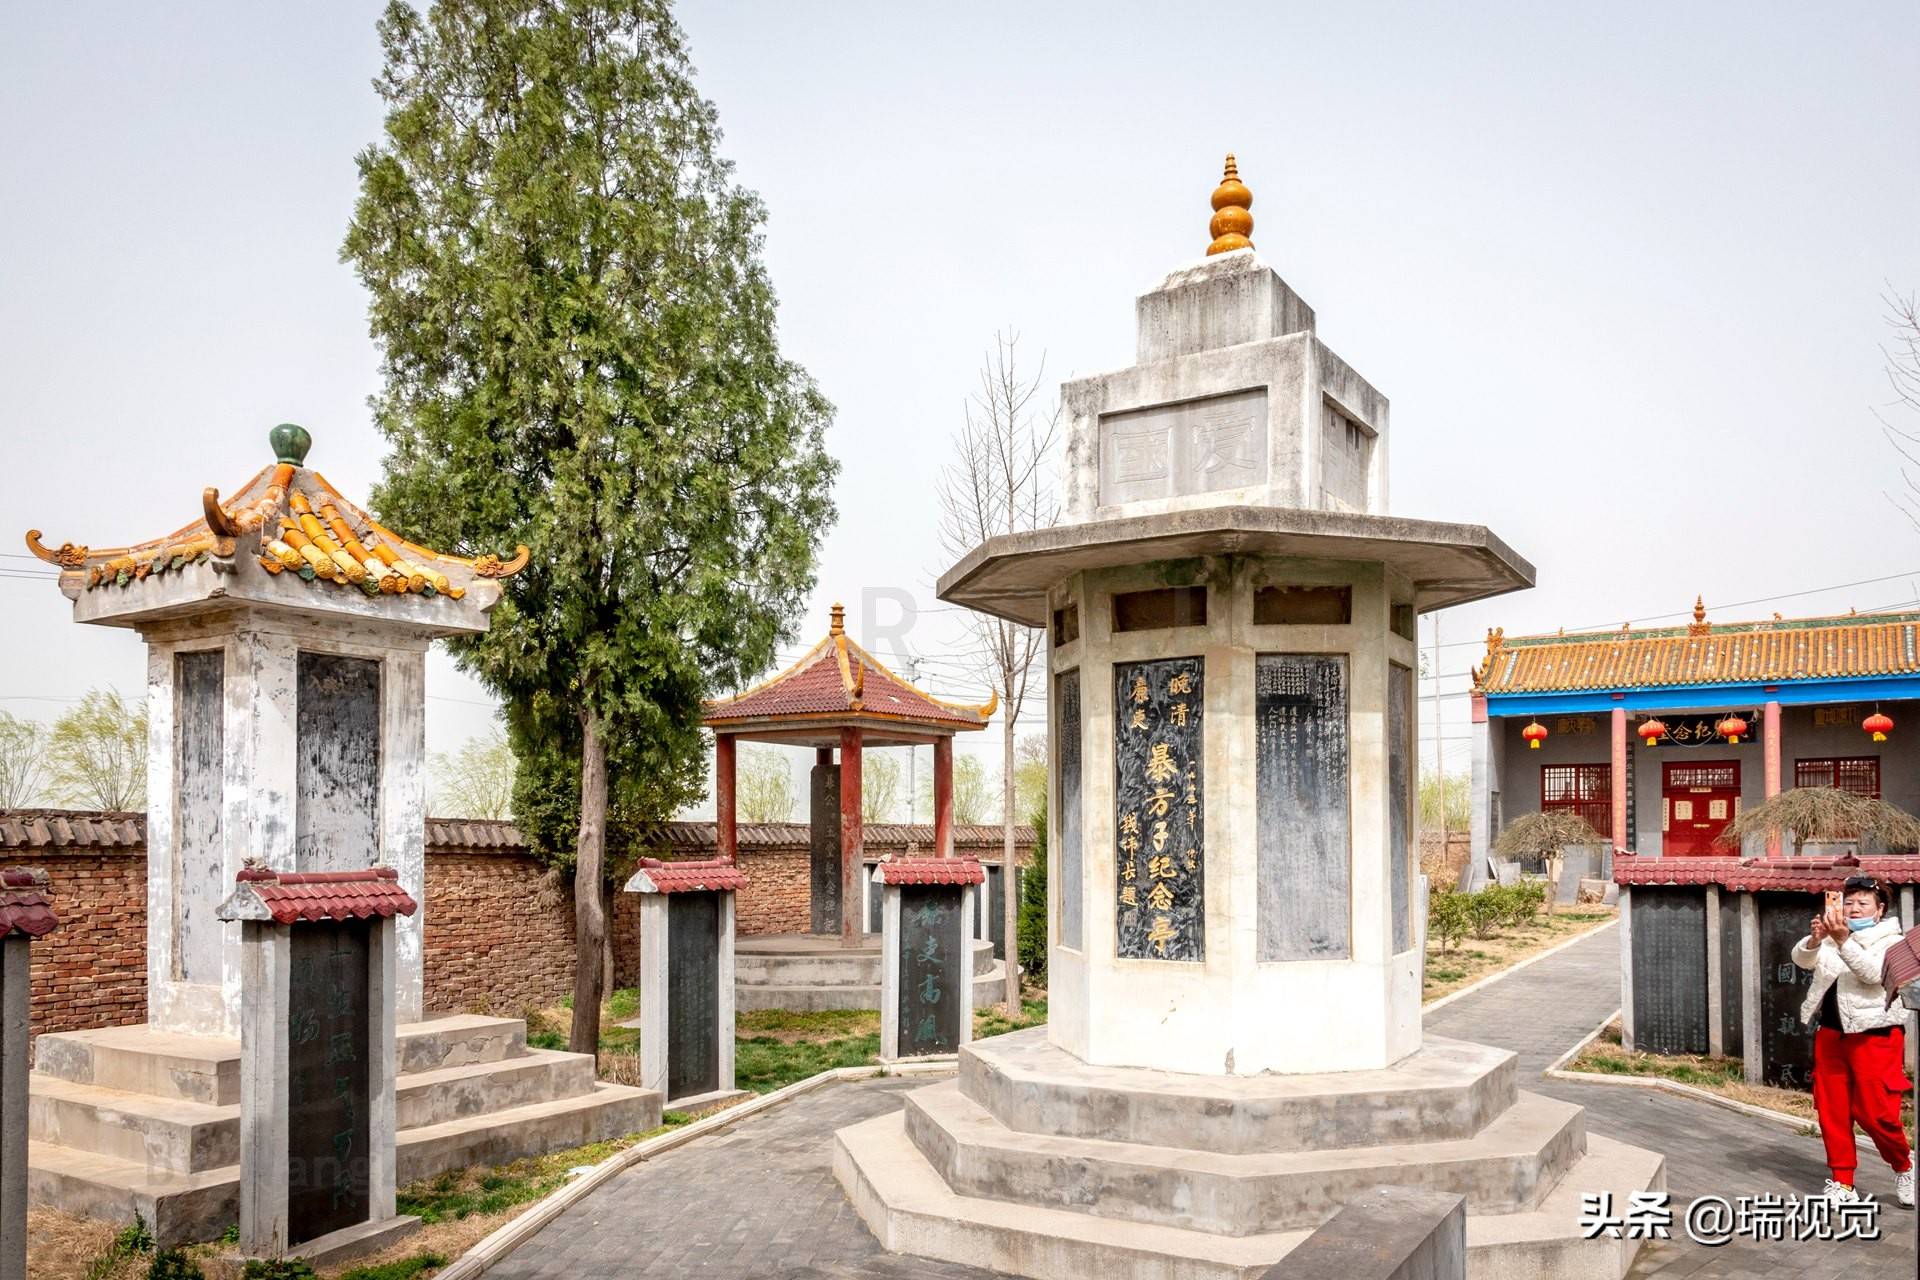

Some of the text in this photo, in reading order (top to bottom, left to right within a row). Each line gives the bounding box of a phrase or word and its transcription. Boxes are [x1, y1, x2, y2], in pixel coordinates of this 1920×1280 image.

[1168, 671, 1192, 727] 晚清
[1146, 743, 1179, 953] 暴方子纪念亭
